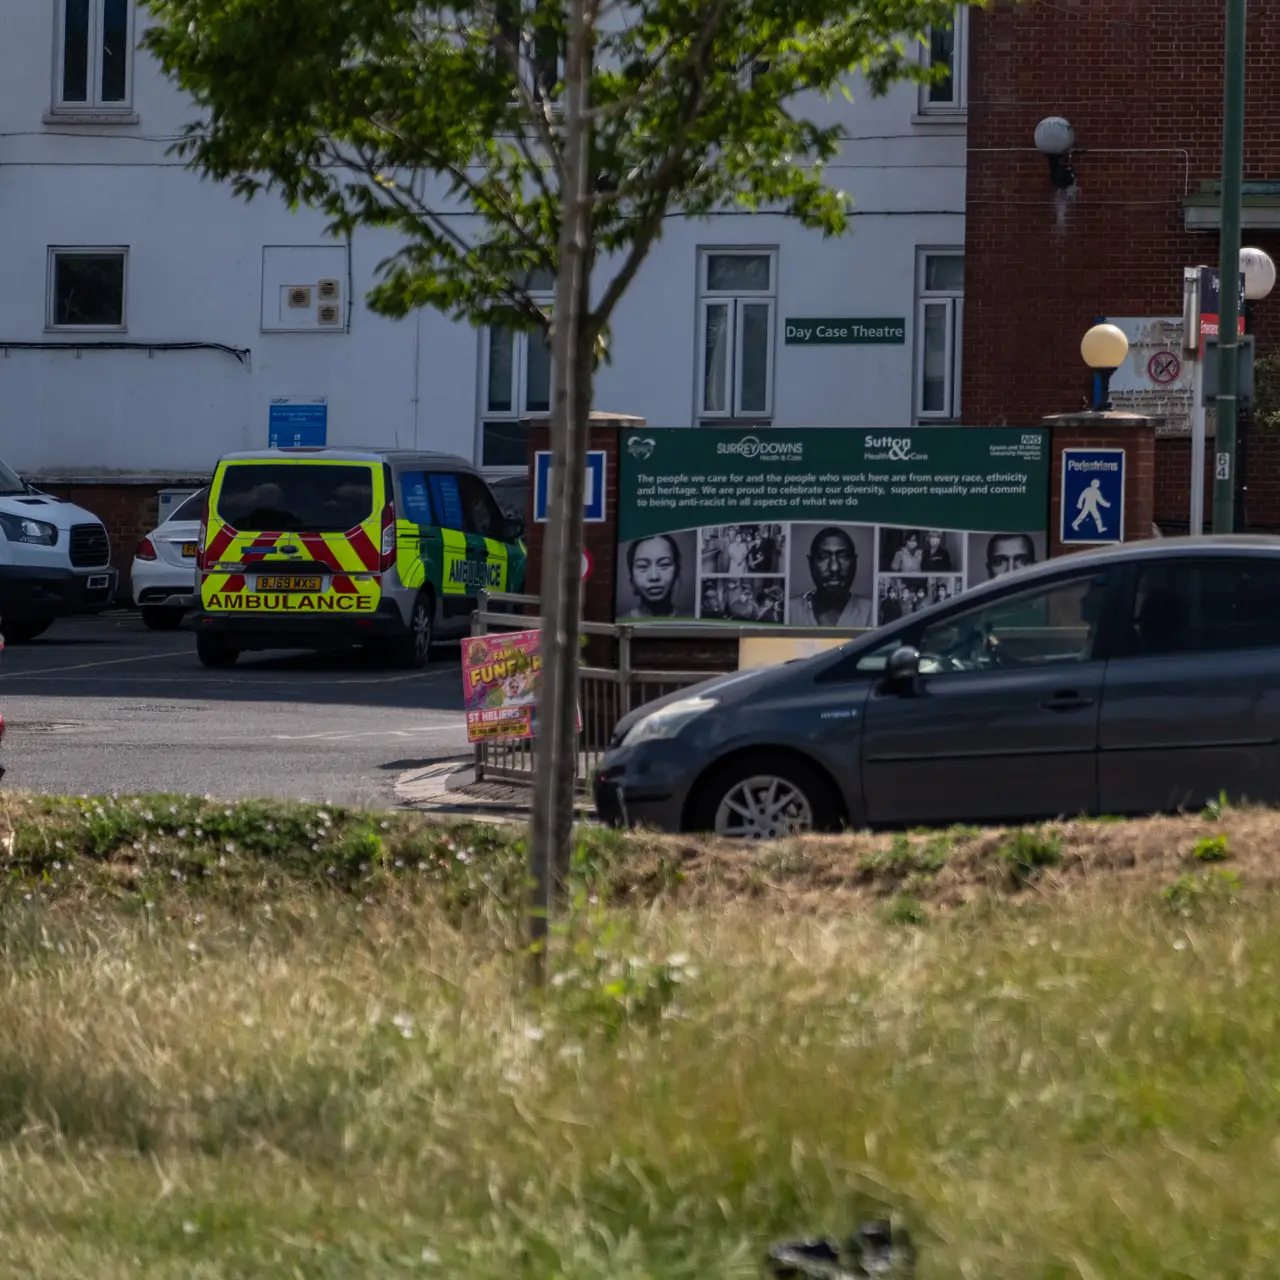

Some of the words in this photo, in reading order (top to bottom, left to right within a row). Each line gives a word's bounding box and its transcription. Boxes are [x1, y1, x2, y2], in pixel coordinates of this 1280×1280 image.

[785, 325, 812, 341] Day
[816, 325, 848, 338] Case
[852, 325, 904, 338] Theatre
[864, 435, 911, 449] Sutton
[1021, 435, 1041, 444] NHS
[716, 442, 757, 454] SURREY
[759, 442, 803, 454] DOWNS
[1068, 459, 1119, 472] Pedestrians
[637, 475, 654, 483] The
[657, 474, 688, 485] people
[729, 474, 743, 483] for
[745, 474, 763, 483] and
[767, 474, 782, 483] the
[785, 473, 816, 485] people
[819, 474, 839, 483] who
[842, 473, 865, 482] work
[868, 473, 889, 482] here
[908, 473, 931, 482] from
[934, 476, 959, 484] every
[962, 475, 984, 484] race,
[986, 473, 1028, 484] ethnicity
[637, 486, 655, 495] and
[657, 486, 699, 497] heritage.
[702, 486, 716, 495] We
[736, 486, 764, 497] proud
[767, 486, 777, 494] to
[780, 485, 822, 494] celebrate
[844, 485, 884, 496] diversity,
[891, 485, 928, 496] support
[930, 485, 967, 496] equality
[970, 485, 987, 494] and
[990, 485, 1026, 494] commit
[637, 499, 647, 507] to
[649, 498, 676, 508] being
[678, 498, 725, 507] anti-racist
[728, 498, 737, 506] in
[739, 498, 750, 506] all
[753, 498, 787, 508] aspects
[789, 497, 800, 506] of
[802, 497, 826, 506] what
[845, 497, 858, 506] do
[448, 558, 502, 587] AMBULANCE
[206, 593, 373, 611] AMBULANCE
